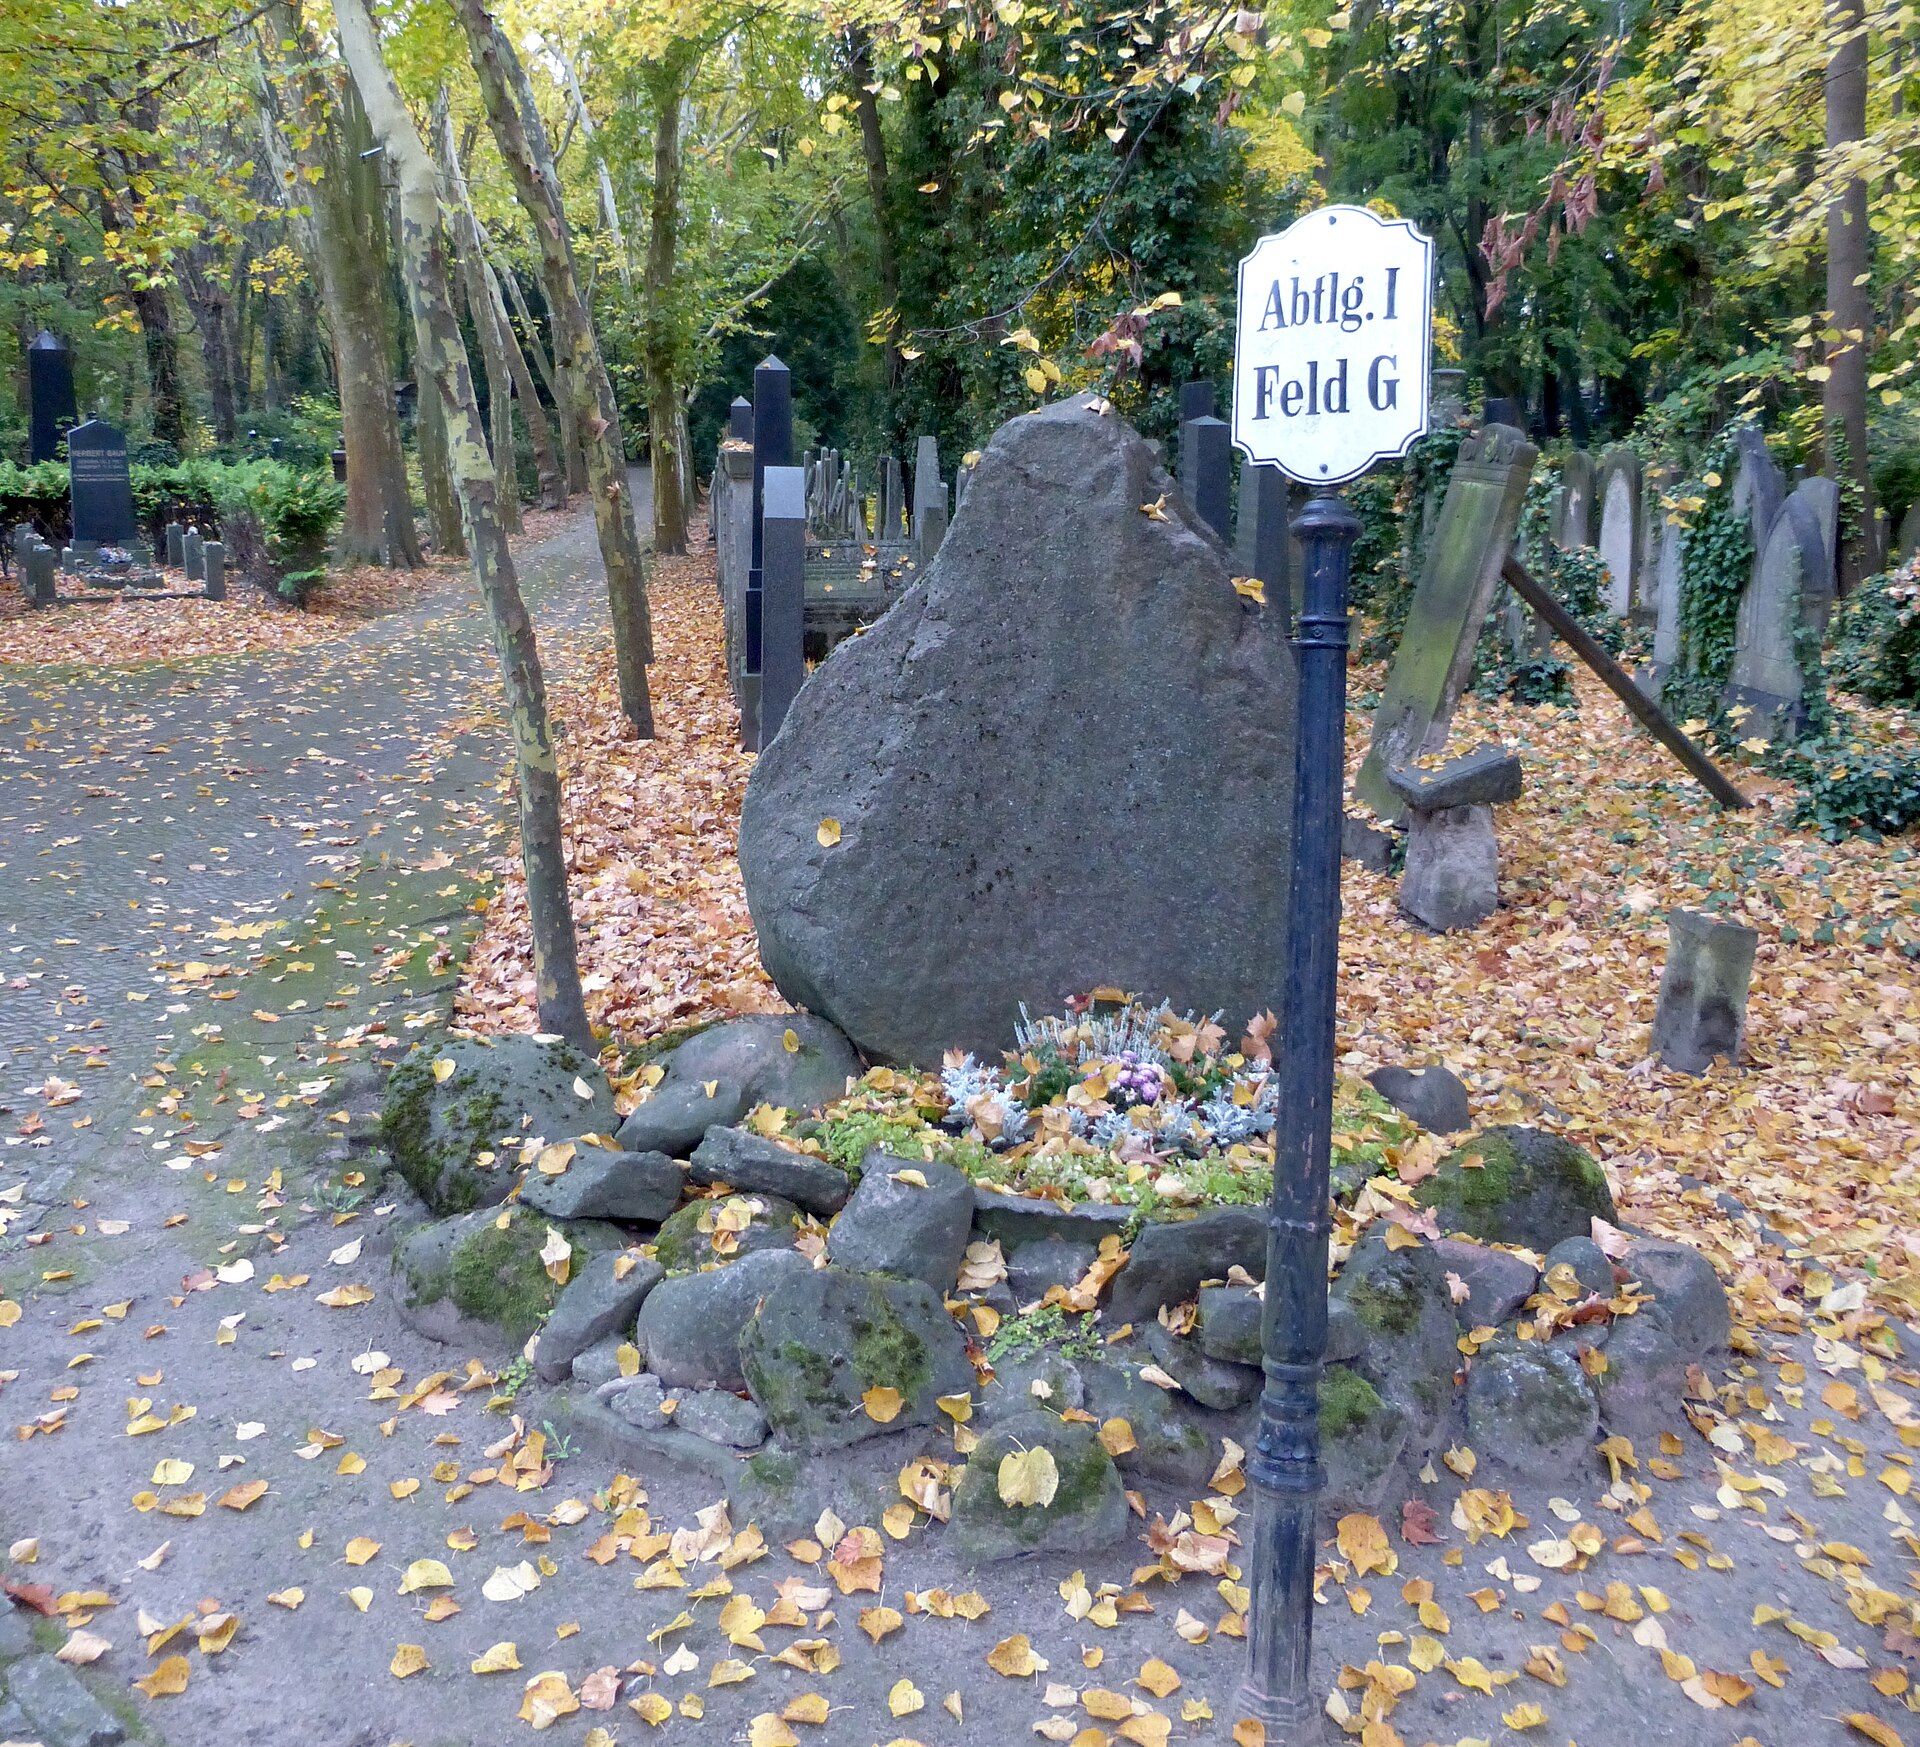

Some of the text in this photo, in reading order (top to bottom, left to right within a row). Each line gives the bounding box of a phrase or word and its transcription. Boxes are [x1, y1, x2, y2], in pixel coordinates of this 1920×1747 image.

[1257, 267, 1400, 333] Abtlg. I
[1252, 354, 1400, 421] Feld G
